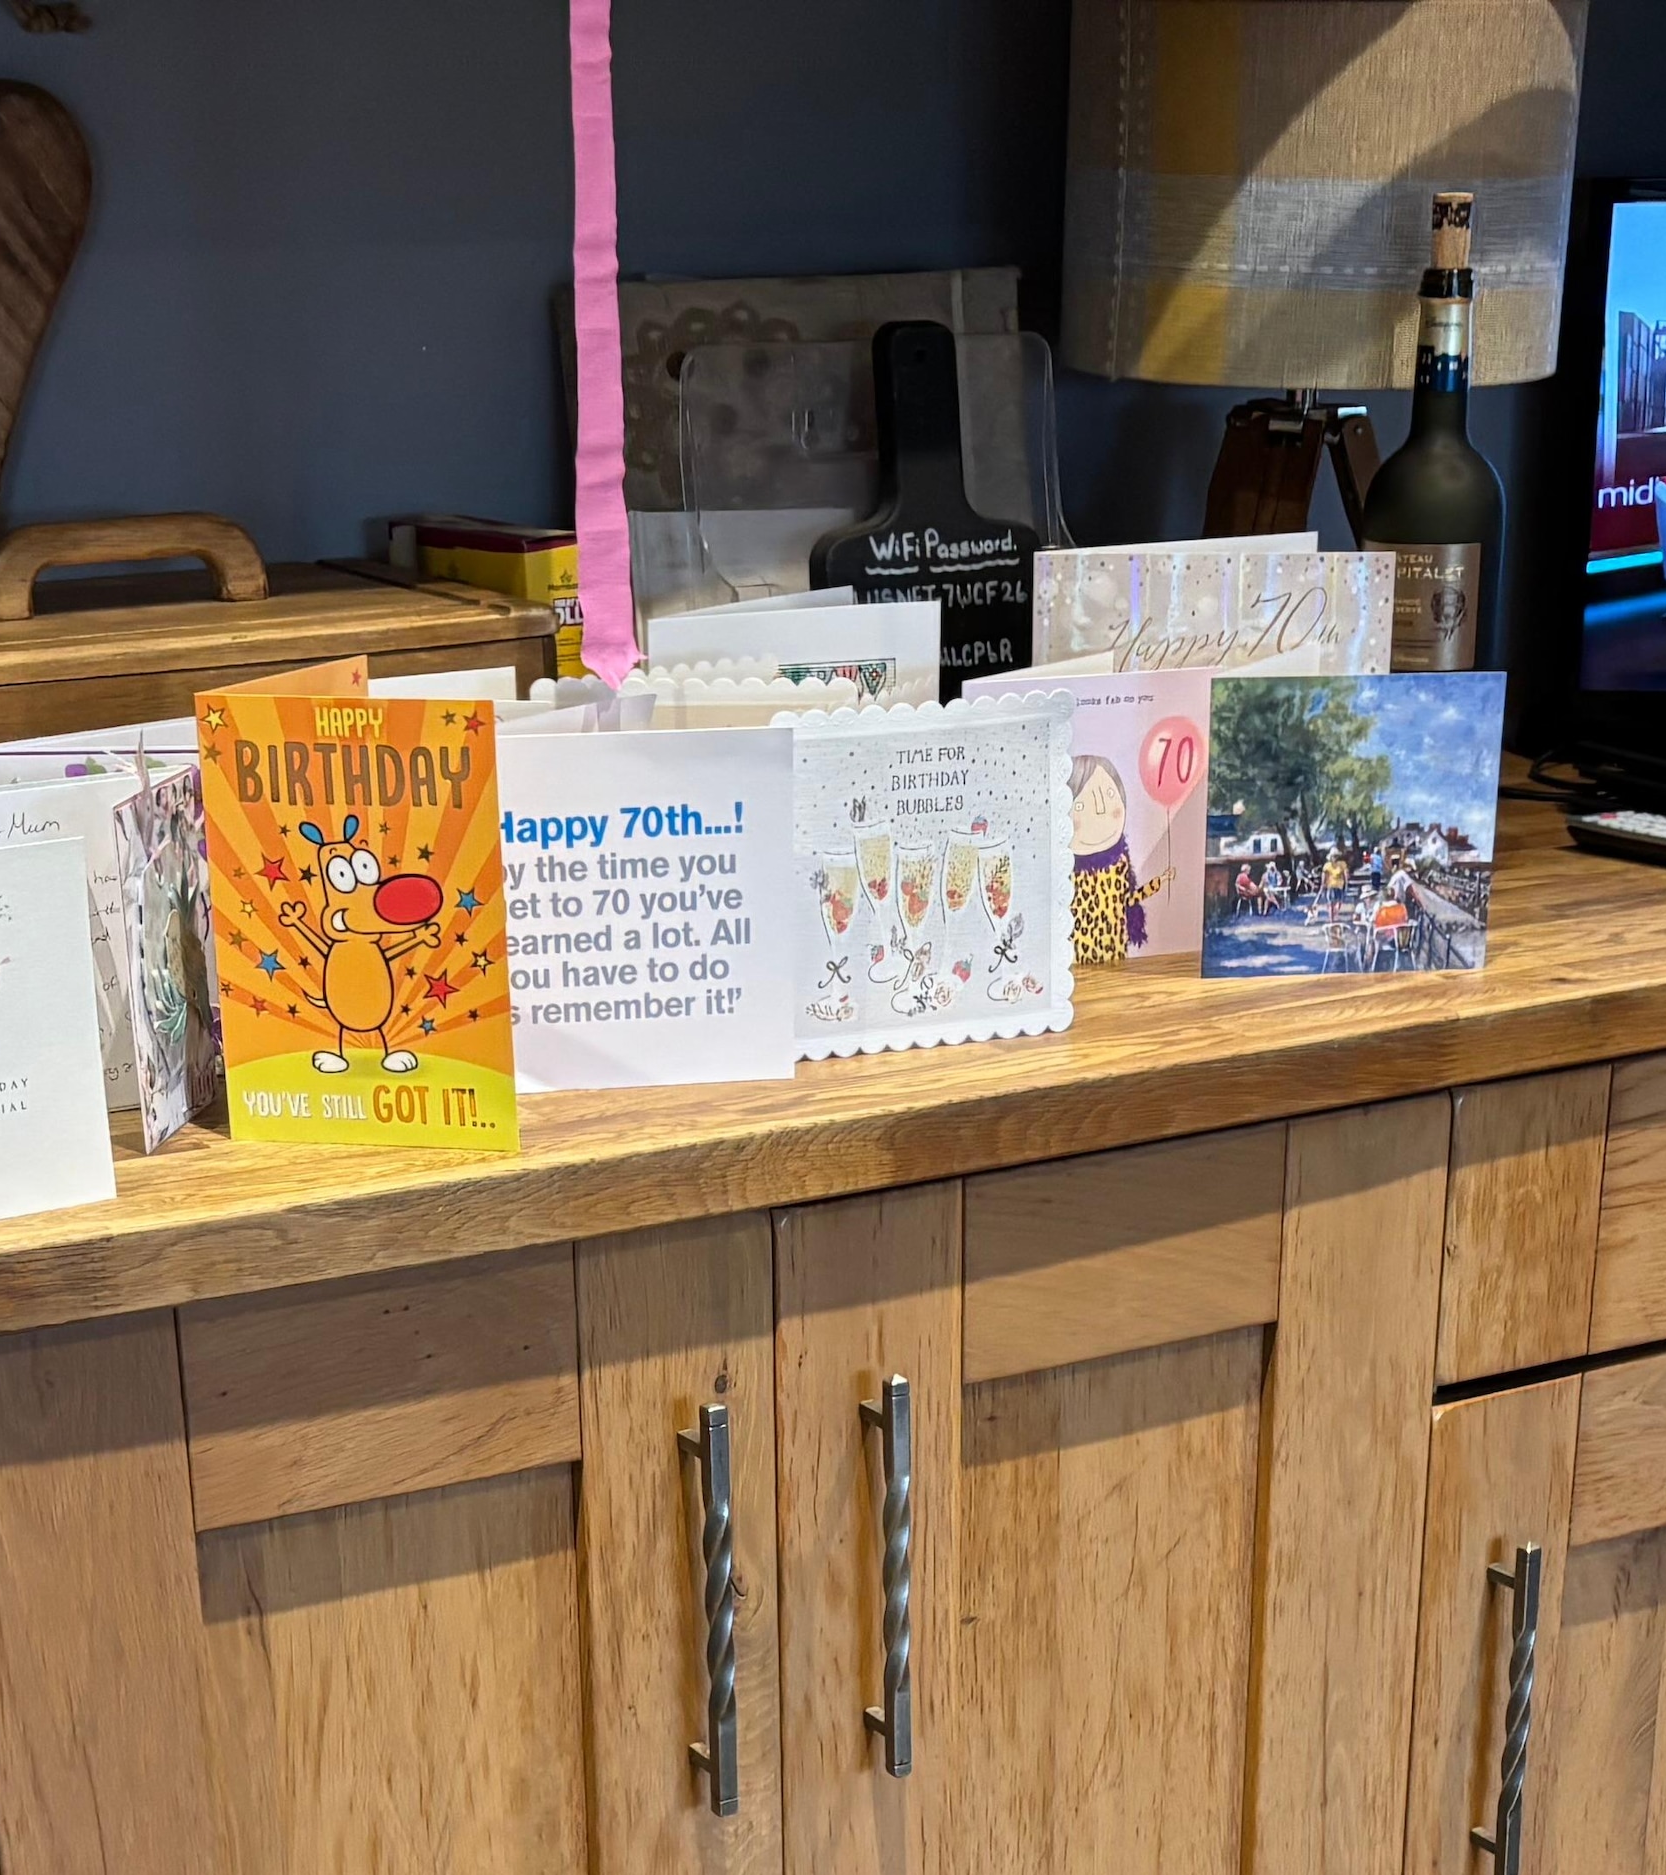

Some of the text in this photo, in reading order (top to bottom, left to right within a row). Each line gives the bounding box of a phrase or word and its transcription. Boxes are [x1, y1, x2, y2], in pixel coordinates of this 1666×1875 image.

[868, 527, 1018, 561] WiFi Password.
[314, 706, 383, 739] HAPPY
[896, 746, 965, 764] TIME FOR
[1157, 735, 1194, 788] 70
[234, 739, 471, 810] BIRTHDAY
[891, 769, 969, 792] BIRTHDAY
[896, 795, 964, 816] BUBBLES
[7, 812, 62, 839] Mum
[535, 855, 588, 883] the
[597, 852, 670, 880] time
[678, 853, 737, 883] you
[549, 891, 583, 919] to
[592, 888, 630, 916] 70
[639, 884, 743, 920] you've
[623, 929, 641, 951] a
[652, 921, 701, 949] lot.
[710, 917, 751, 946] All
[562, 960, 638, 988] have
[646, 957, 679, 983] to
[688, 953, 730, 981] do
[531, 991, 696, 1025] remember
[242, 1090, 312, 1118] YOU'VE
[322, 1094, 367, 1121] STILL
[372, 1084, 430, 1125] GOT
